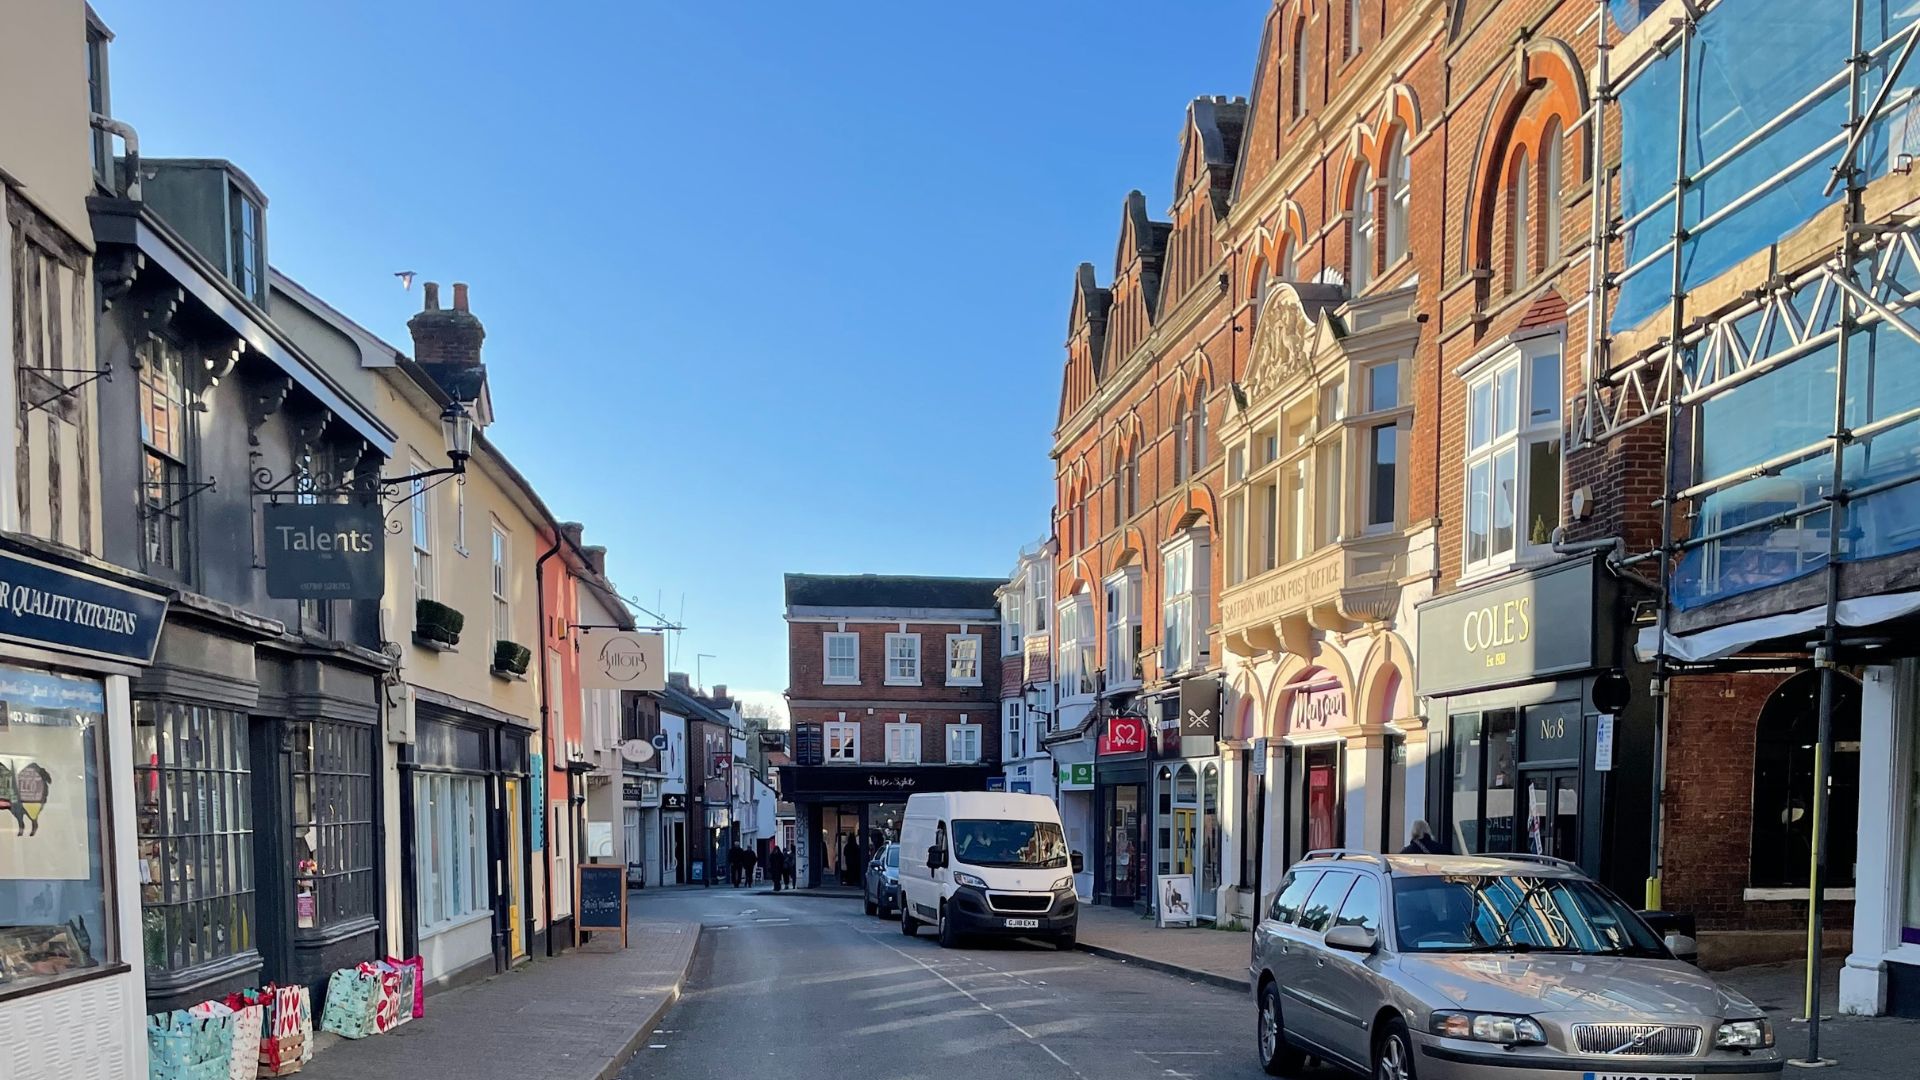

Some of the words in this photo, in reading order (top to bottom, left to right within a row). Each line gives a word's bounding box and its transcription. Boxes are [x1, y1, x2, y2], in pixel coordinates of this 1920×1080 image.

[275, 525, 373, 552] Talents
[12, 584, 74, 622] QUALITY
[74, 599, 137, 635] KITCHENS
[1225, 597, 1255, 620] SAFFRON
[1255, 583, 1286, 609] WALDEN
[1288, 574, 1309, 599] POST
[1311, 561, 1340, 590] OFFICE
[1463, 596, 1530, 653] COLE'S
[1295, 689, 1347, 730] Monsoon
[1557, 717, 1564, 739] 8
